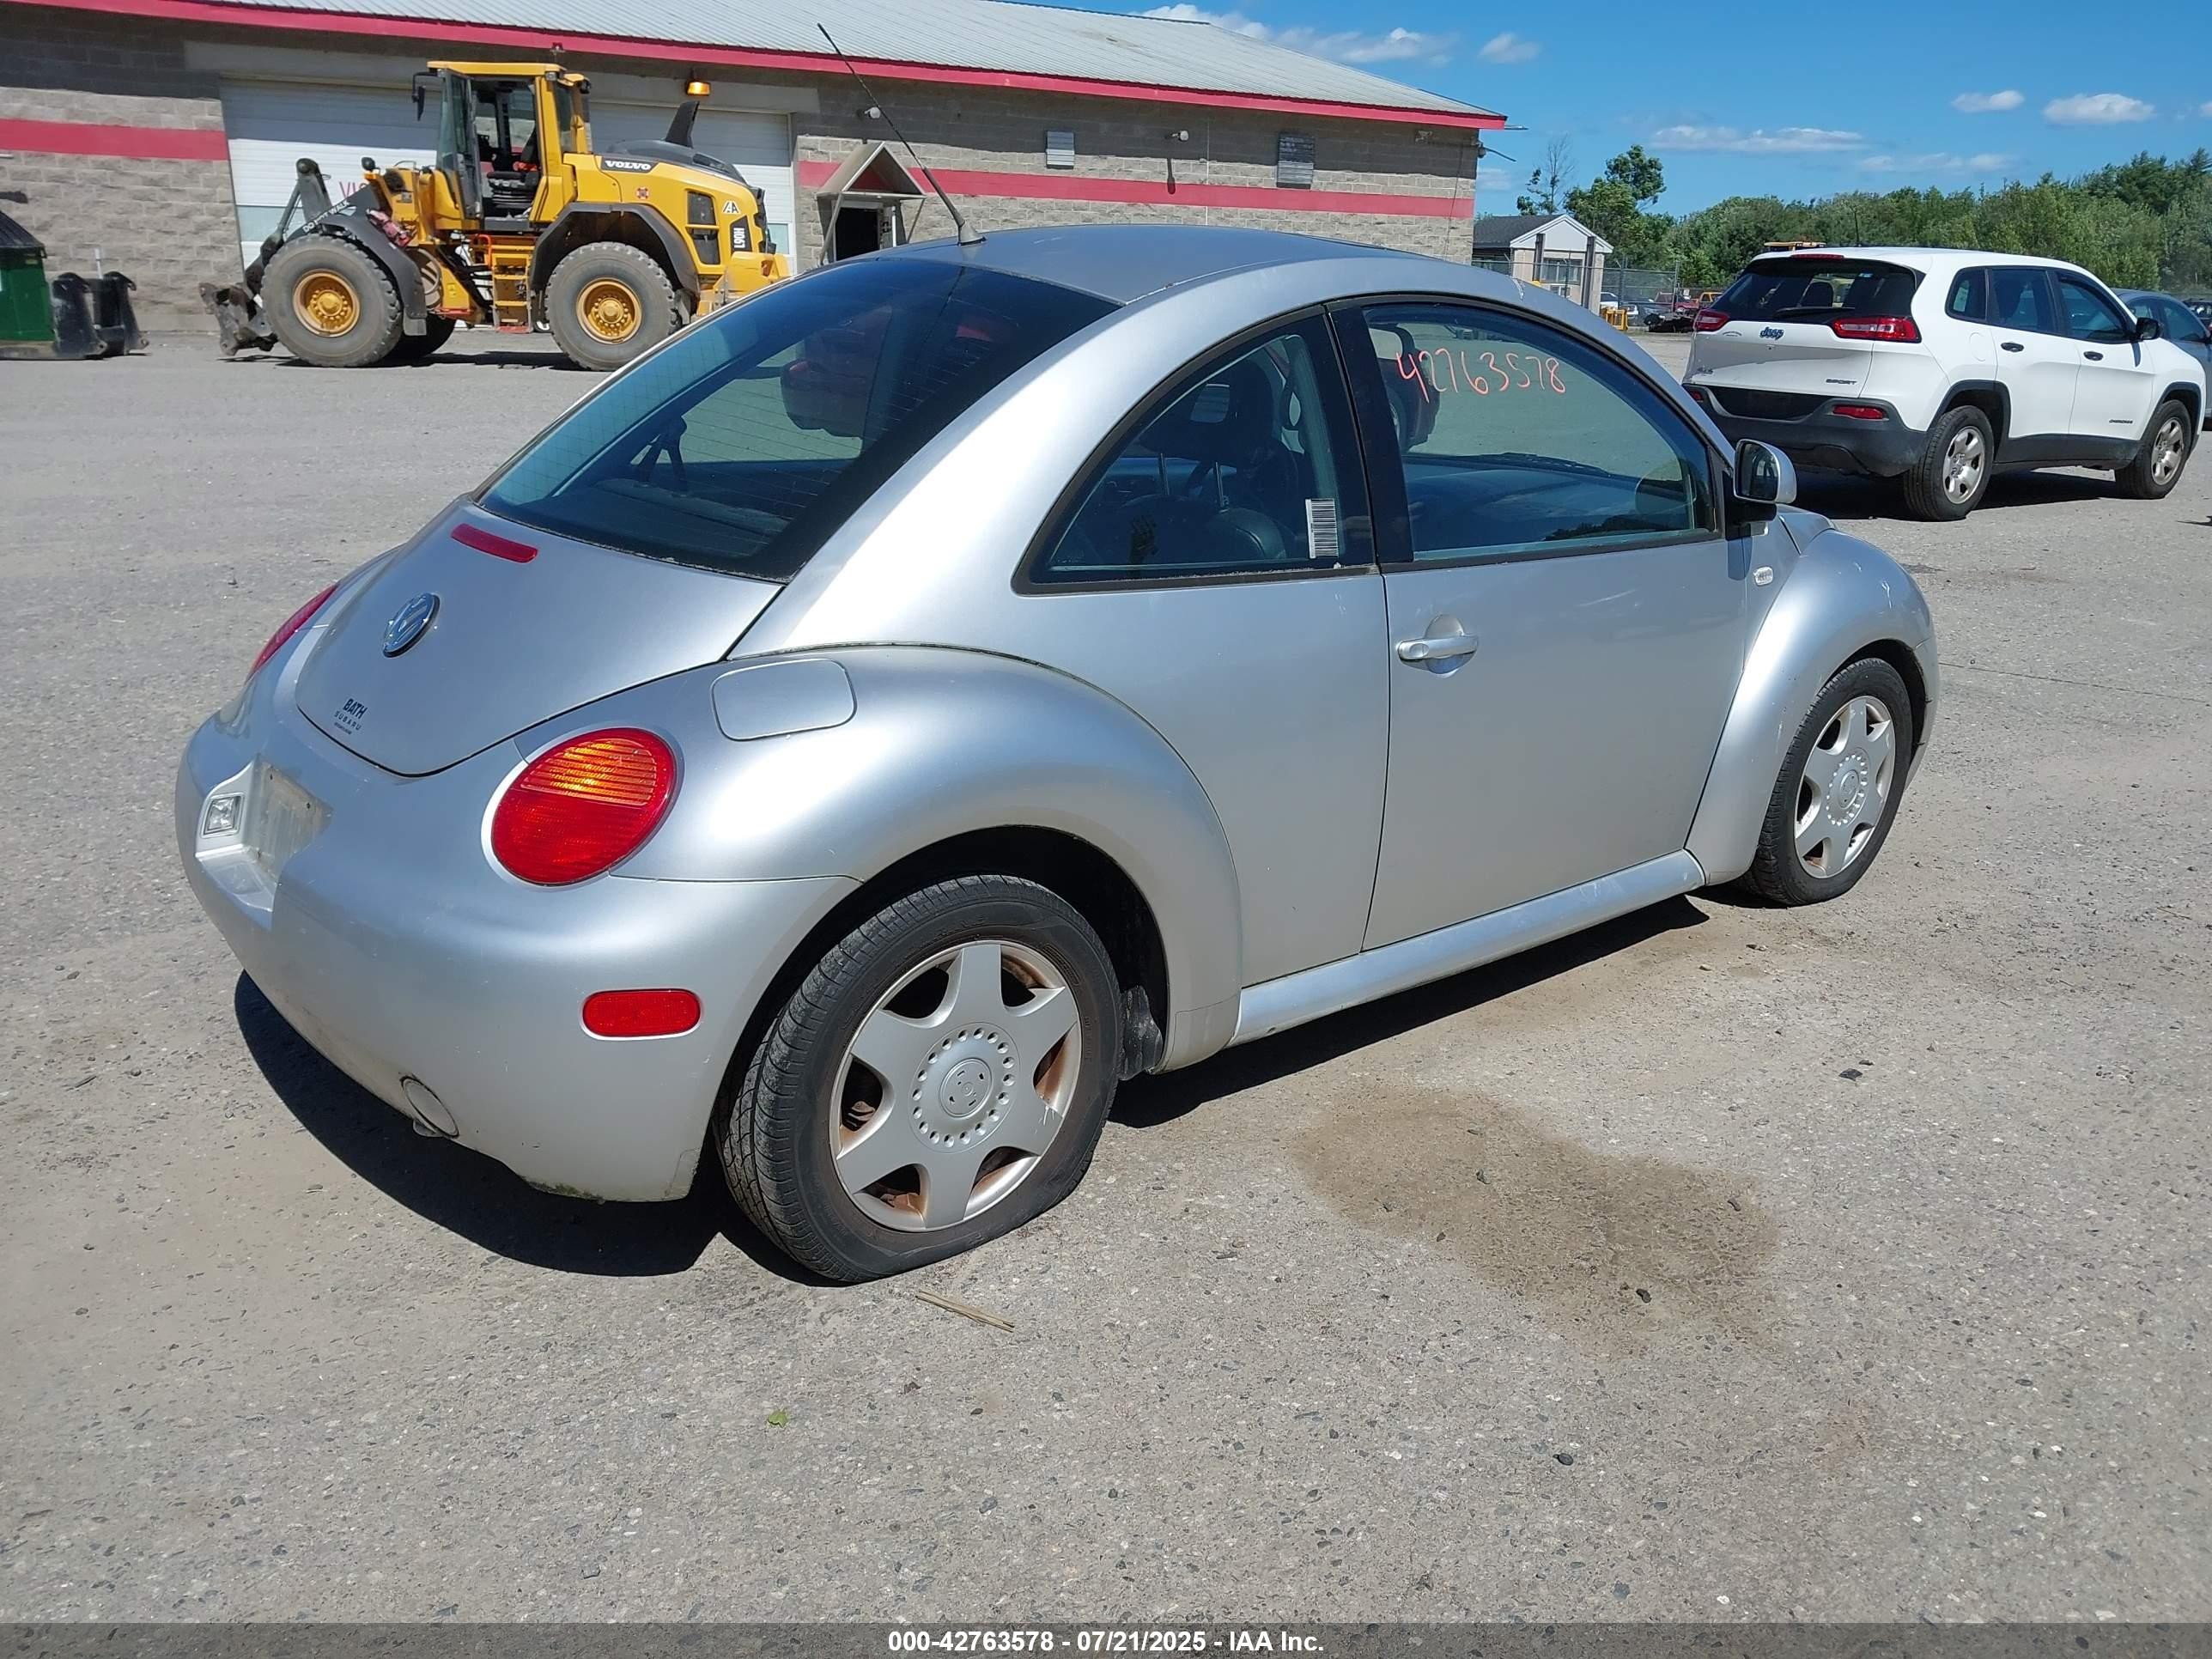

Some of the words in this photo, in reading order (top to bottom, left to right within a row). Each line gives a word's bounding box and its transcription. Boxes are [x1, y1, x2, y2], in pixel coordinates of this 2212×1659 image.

[605, 160, 652, 171] VOLVO
[302, 221, 315, 233] DO
[329, 200, 351, 215] WALK
[733, 227, 746, 248] L90H
[1759, 326, 1784, 341] Jeep
[1395, 347, 1566, 404] 42763578
[343, 697, 368, 720] BATH
